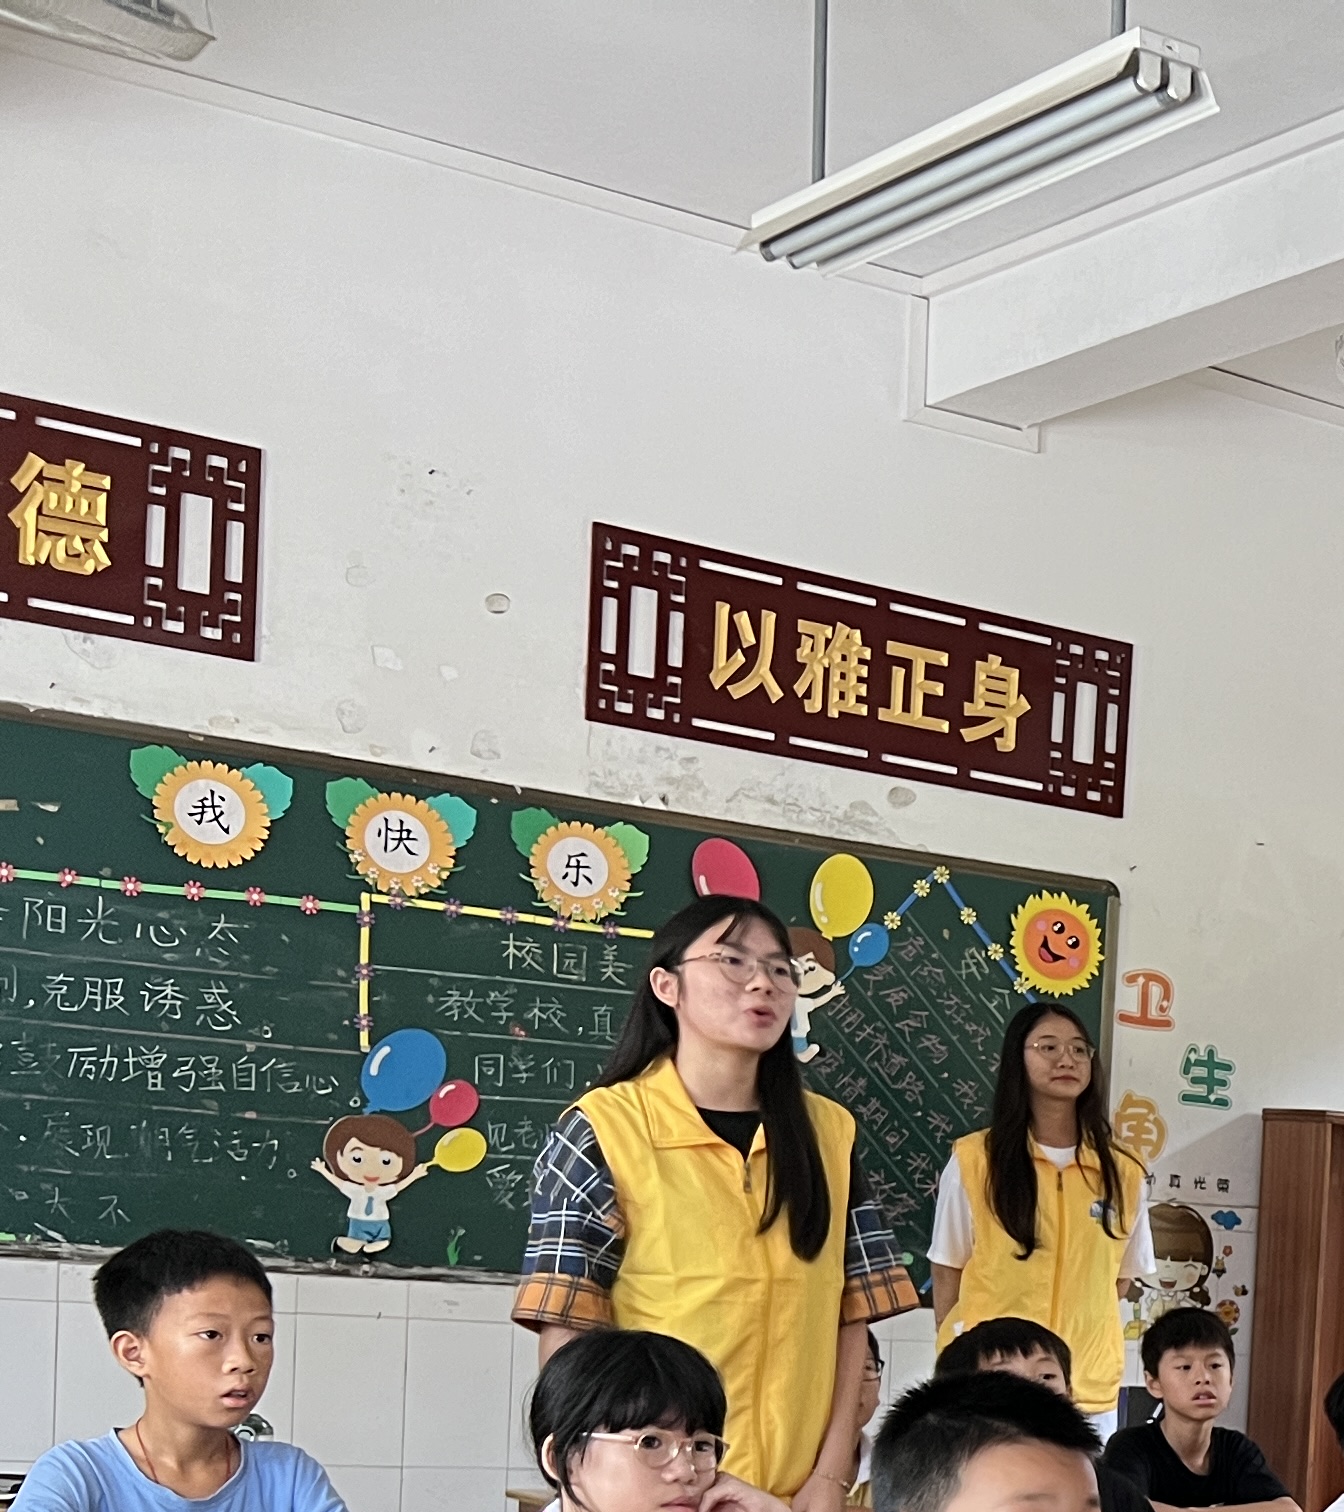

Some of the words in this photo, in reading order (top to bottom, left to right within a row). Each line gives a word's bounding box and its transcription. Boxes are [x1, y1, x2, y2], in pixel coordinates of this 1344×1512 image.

[8, 451, 113, 576] 德
[708, 600, 1031, 754] 以雅正身
[187, 788, 231, 835] 我
[377, 817, 420, 856] 快
[561, 852, 594, 888] 乐
[0, 895, 251, 957] 阳光心态
